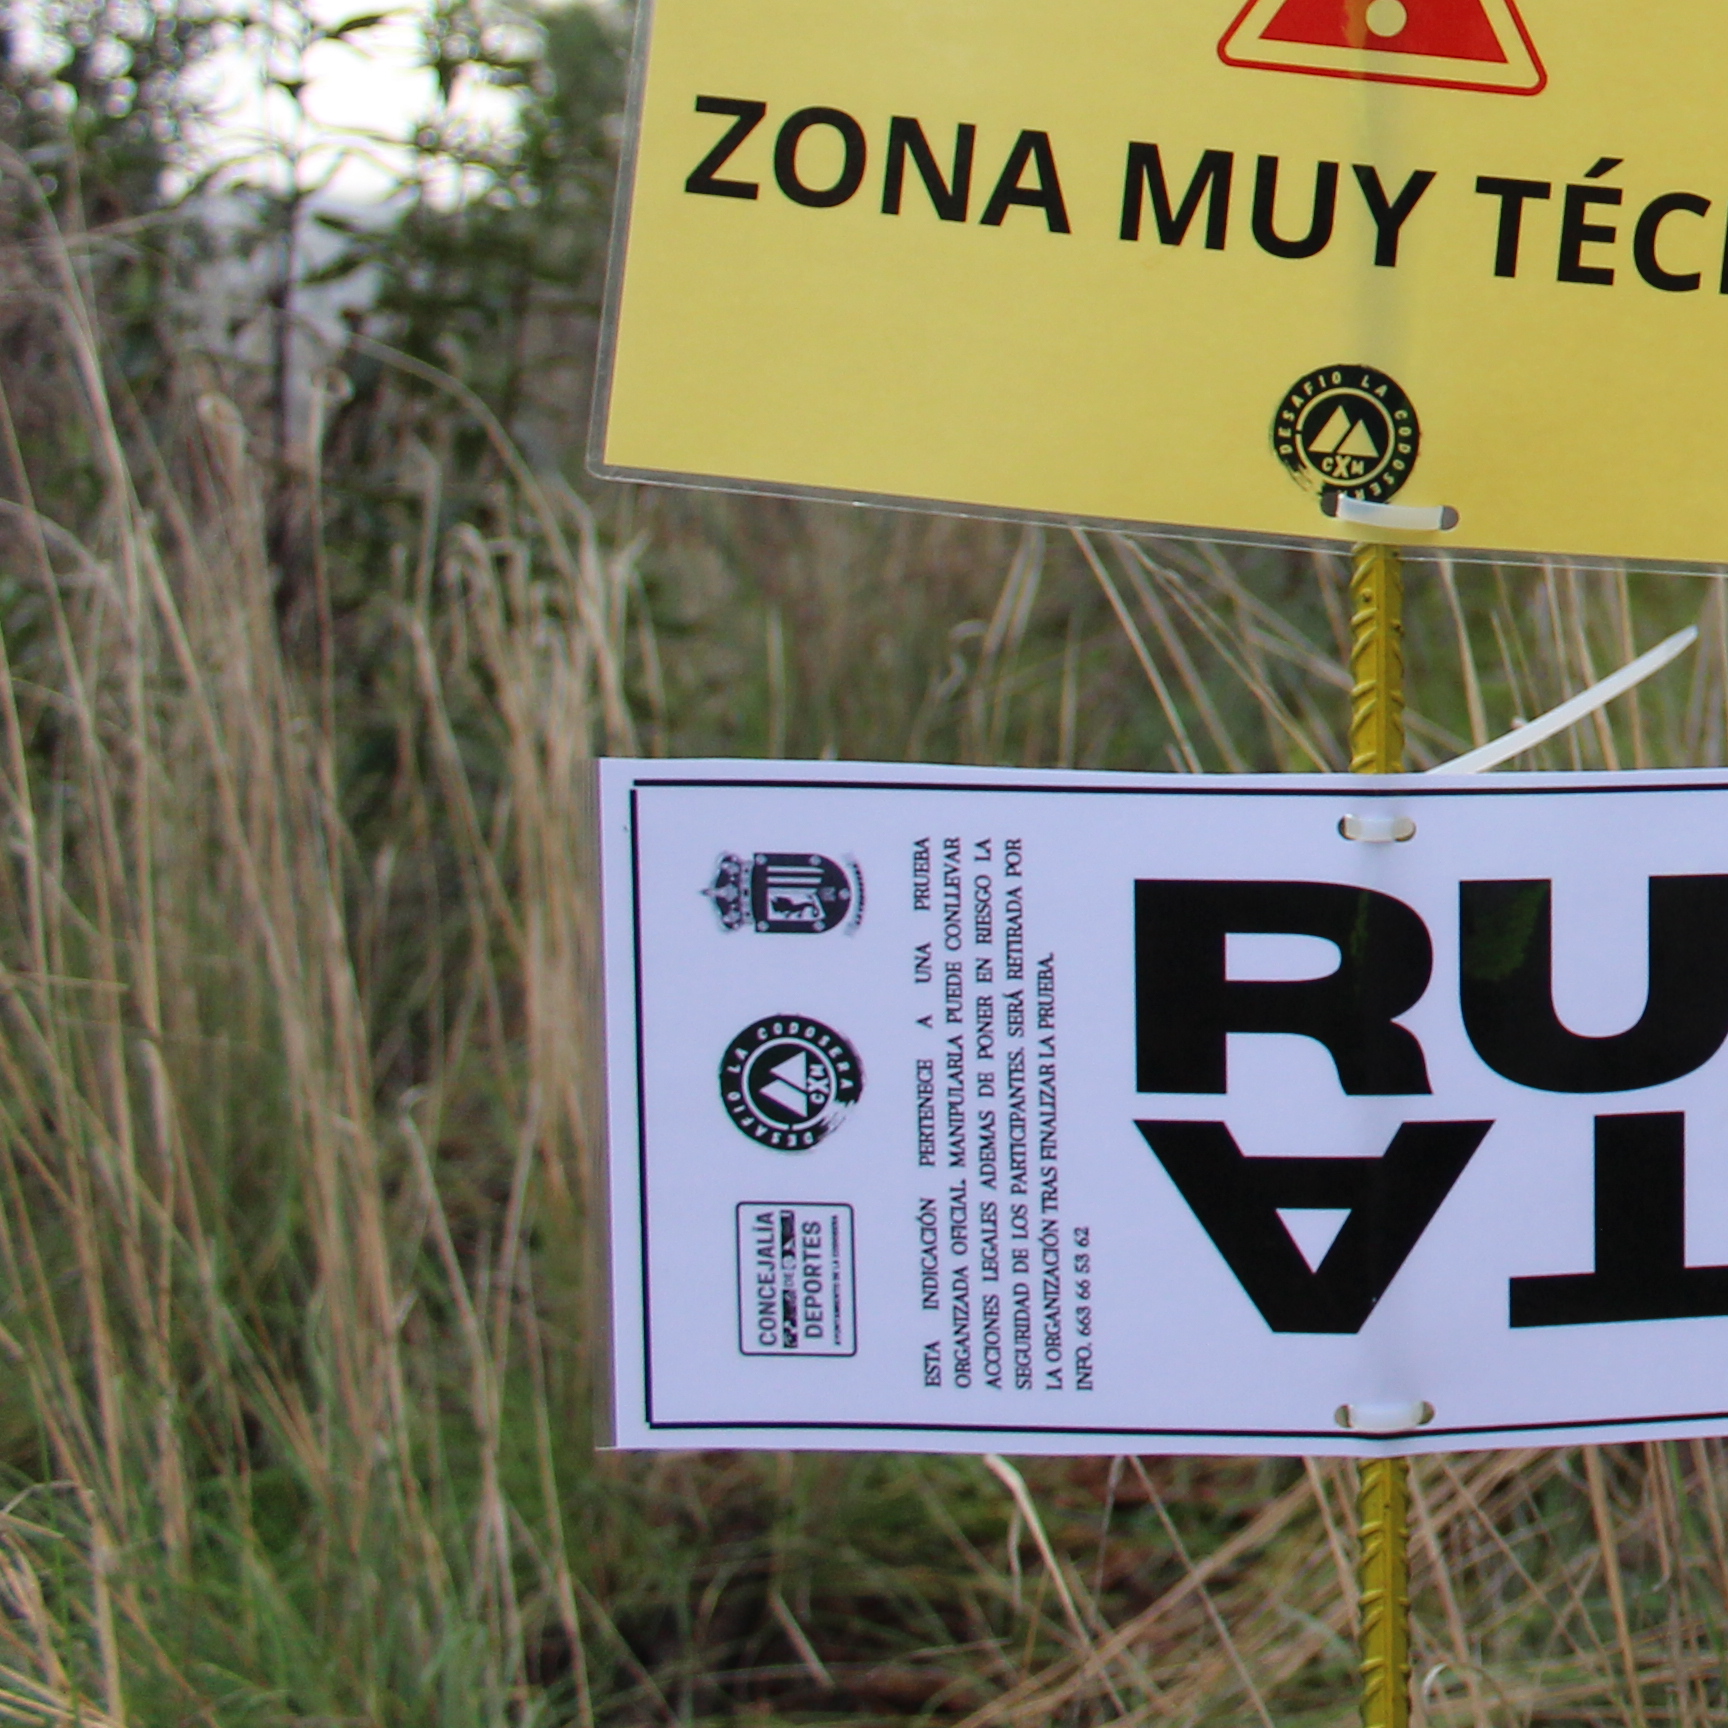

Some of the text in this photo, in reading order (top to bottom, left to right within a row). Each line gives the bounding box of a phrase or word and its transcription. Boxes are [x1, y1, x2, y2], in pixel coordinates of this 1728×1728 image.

[683, 94, 1072, 236] ZONA
[1118, 140, 1438, 269] MUY
[1278, 370, 1413, 501] DESAFIO LA CODOSER
[1321, 454, 1366, 479] CXM
[726, 1019, 855, 1147] DESAFIO LA CODOSERA
[806, 1062, 831, 1104] CXM
[912, 836, 943, 1388] ESTA INDICACIÓN PERTENECE A UNA PRUEBA
[942, 836, 973, 1390] ORGANIZADA OFICIAL. MANIPULARLA PUEDE CONLLEVAR
[973, 837, 1003, 1391] ACCIONES LEGALES ADEMAS DE PONER EN RIESGO LA
[1001, 837, 1033, 1391] SEGURIDAD DE LOS PARTICIPANTES. SERÁ RETIRADA POR
[1036, 951, 1064, 1391] LA ORGANIZACIÓN TRAS FINALIZAR LA PRUEBA.
[751, 1211, 778, 1347] CONCEJALÍA
[783, 1273, 795, 1288] DE
[801, 1220, 824, 1339] DEPORTES
[1072, 1226, 1094, 1392] INFO. 663 66 53 62
